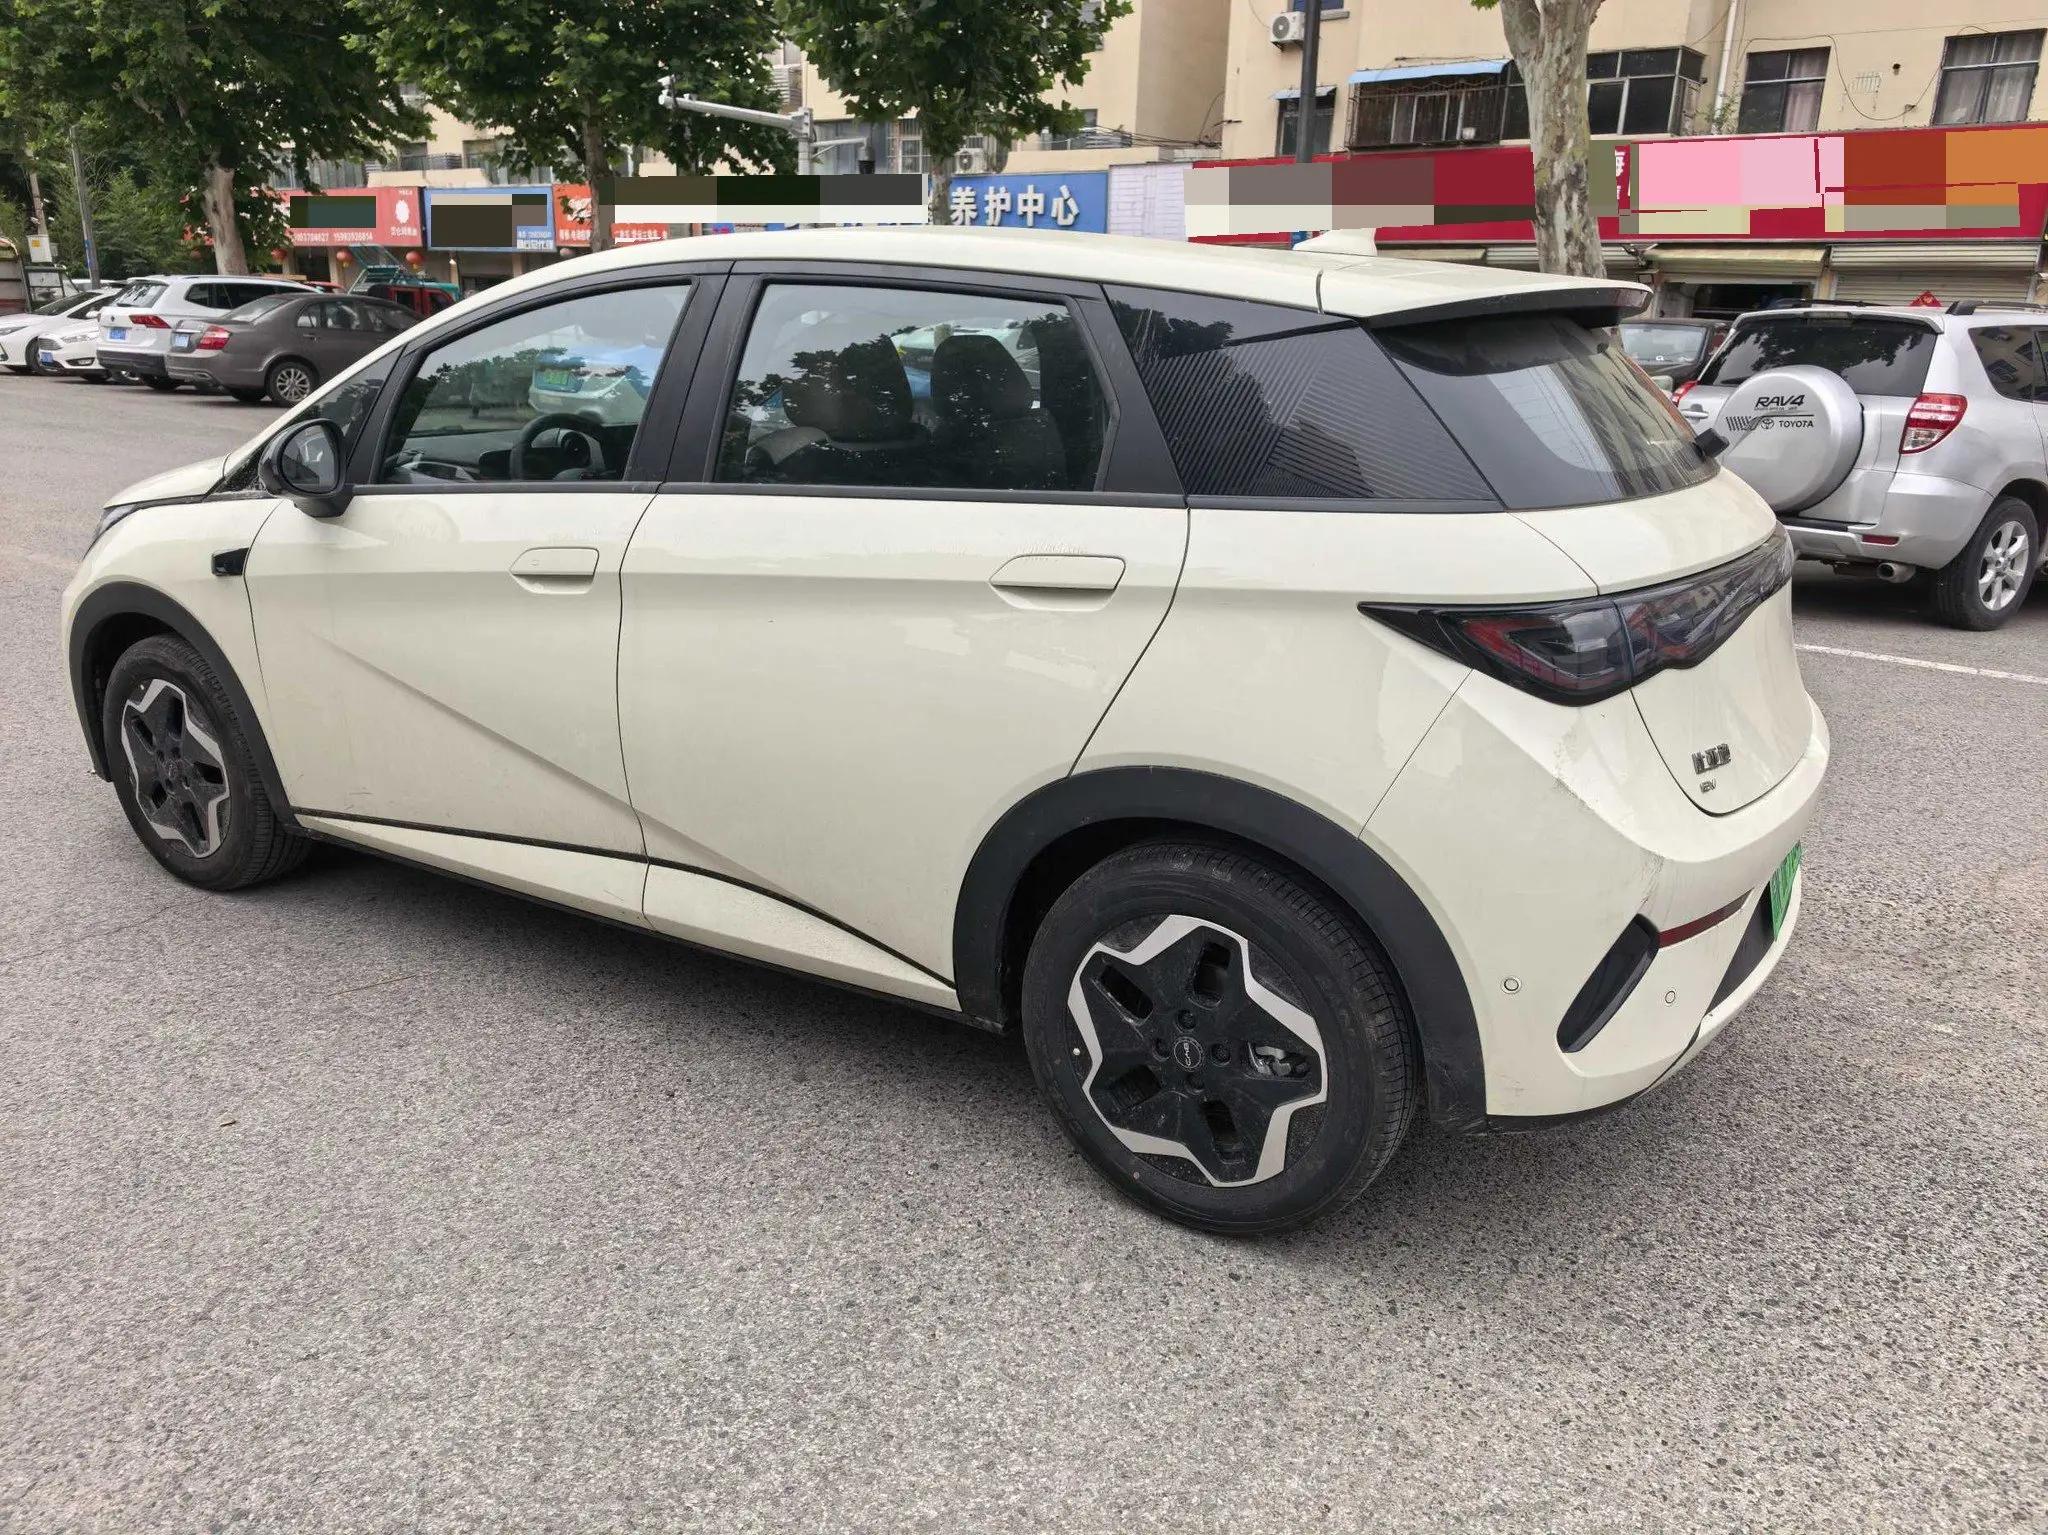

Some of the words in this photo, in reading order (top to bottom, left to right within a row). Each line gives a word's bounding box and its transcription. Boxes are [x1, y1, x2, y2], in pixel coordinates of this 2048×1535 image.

[950, 184, 1080, 227] 养护中心
[1755, 394, 1805, 407] RAV4
[1779, 420, 1814, 428] TOYOTA
